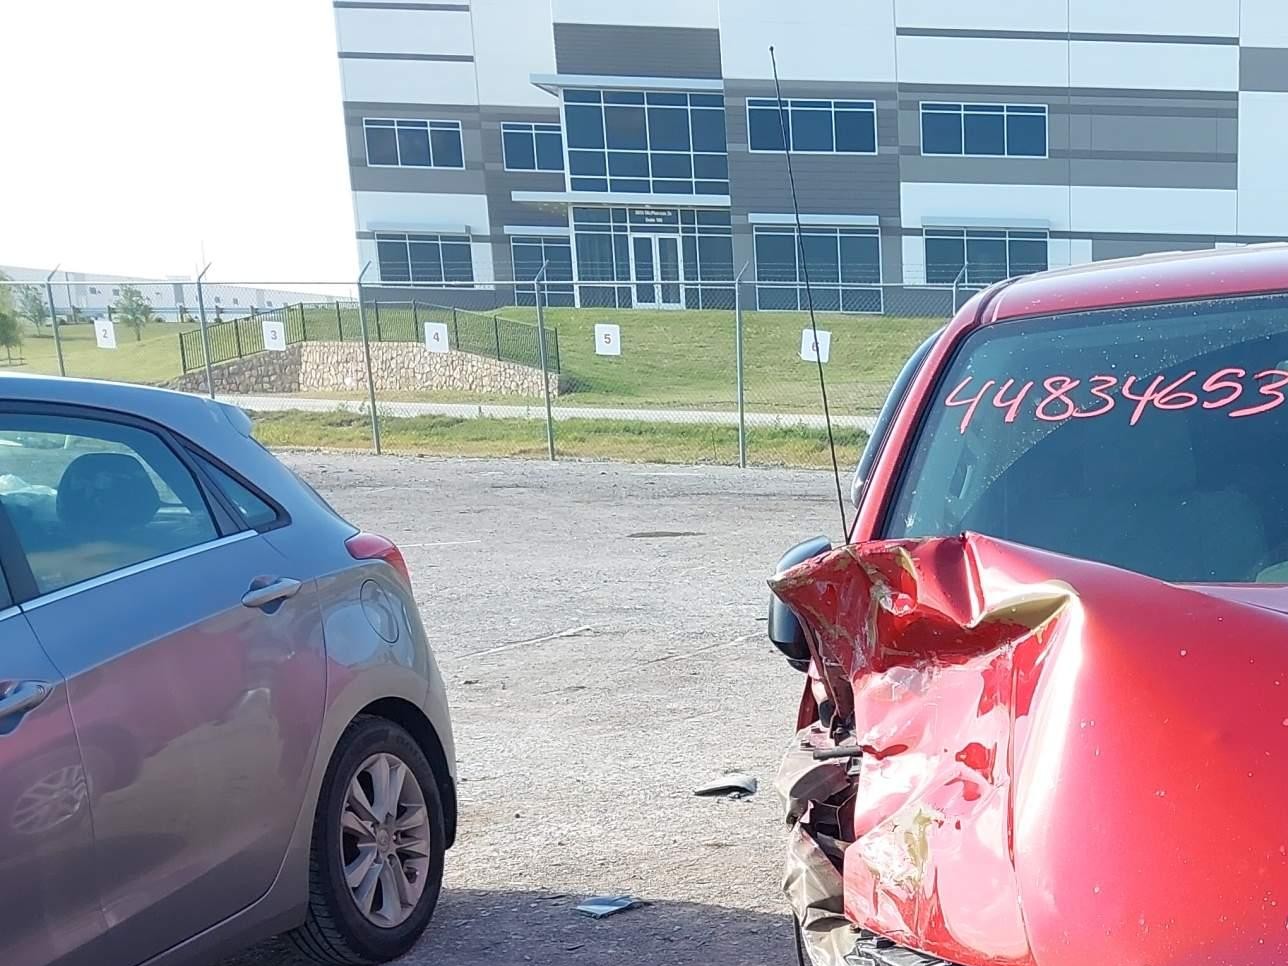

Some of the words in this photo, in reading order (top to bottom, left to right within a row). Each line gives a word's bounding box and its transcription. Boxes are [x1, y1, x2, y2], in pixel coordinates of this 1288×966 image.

[101, 328, 109, 339] 2
[270, 329, 279, 341] 3
[432, 331, 441, 343] 4
[603, 332, 612, 345] 5
